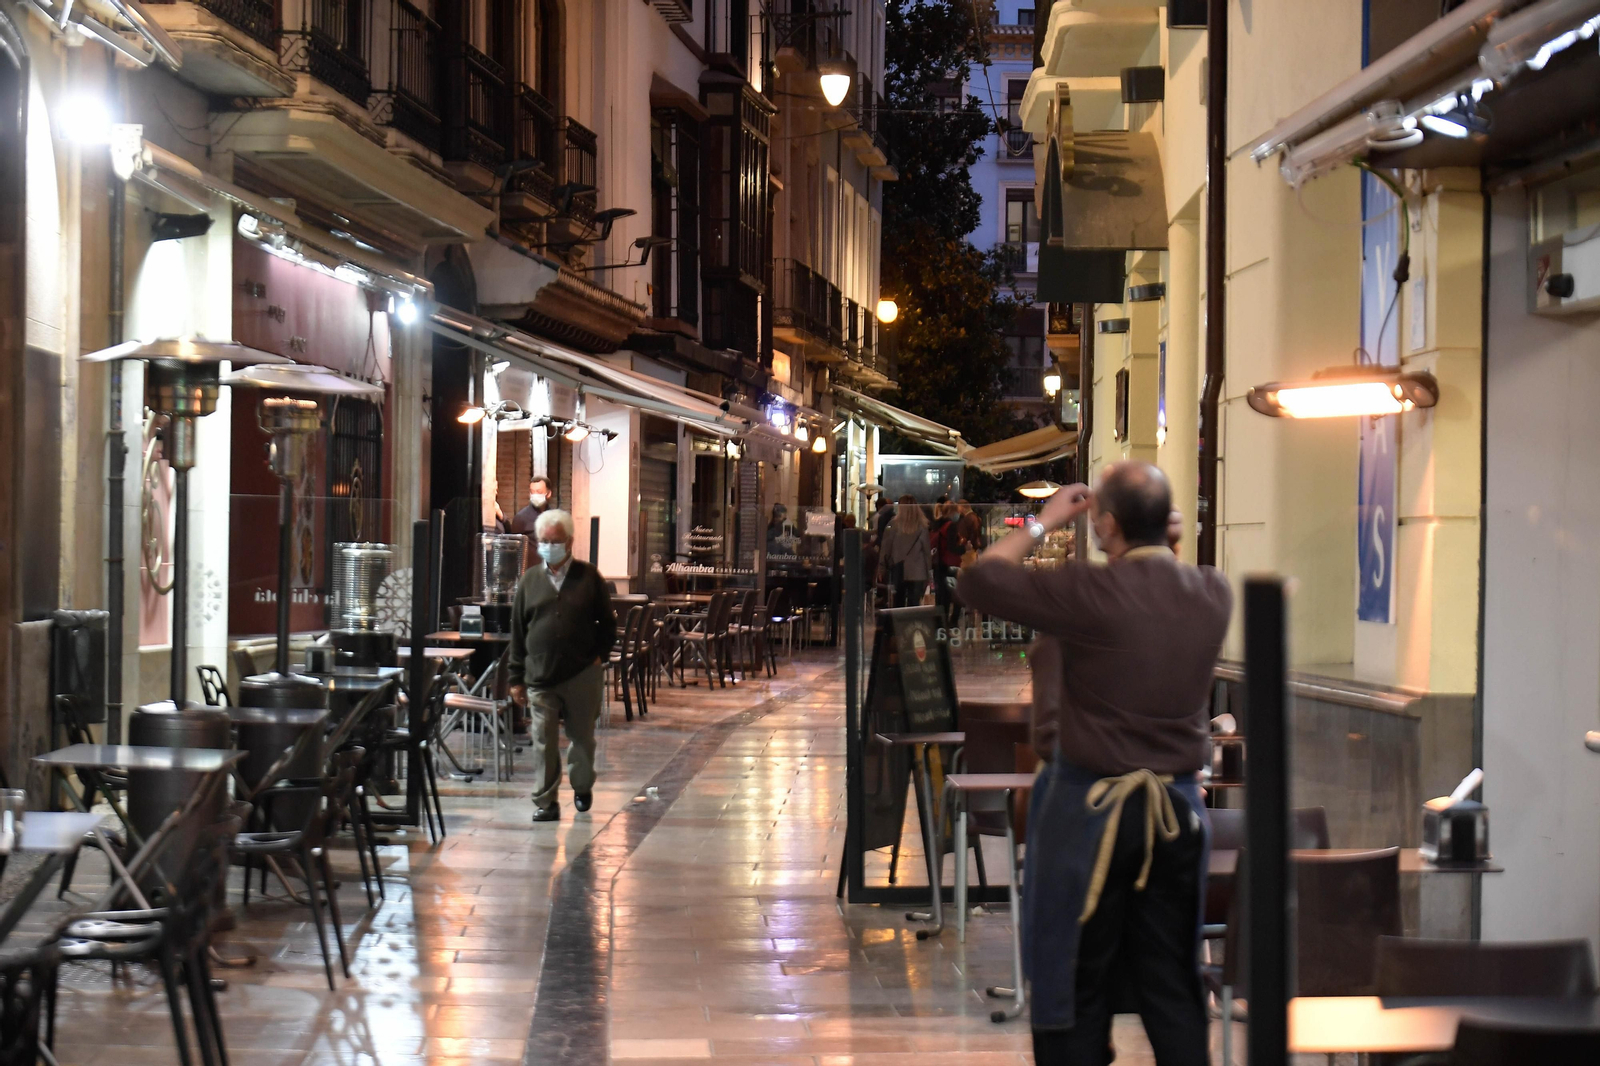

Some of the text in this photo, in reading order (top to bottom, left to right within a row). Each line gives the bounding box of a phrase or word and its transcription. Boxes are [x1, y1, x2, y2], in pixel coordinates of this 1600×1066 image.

[691, 525, 714, 533] Nuevo
[682, 532, 724, 541] Restaurante
[766, 552, 797, 560] hambra
[666, 562, 714, 573] Alhambra
